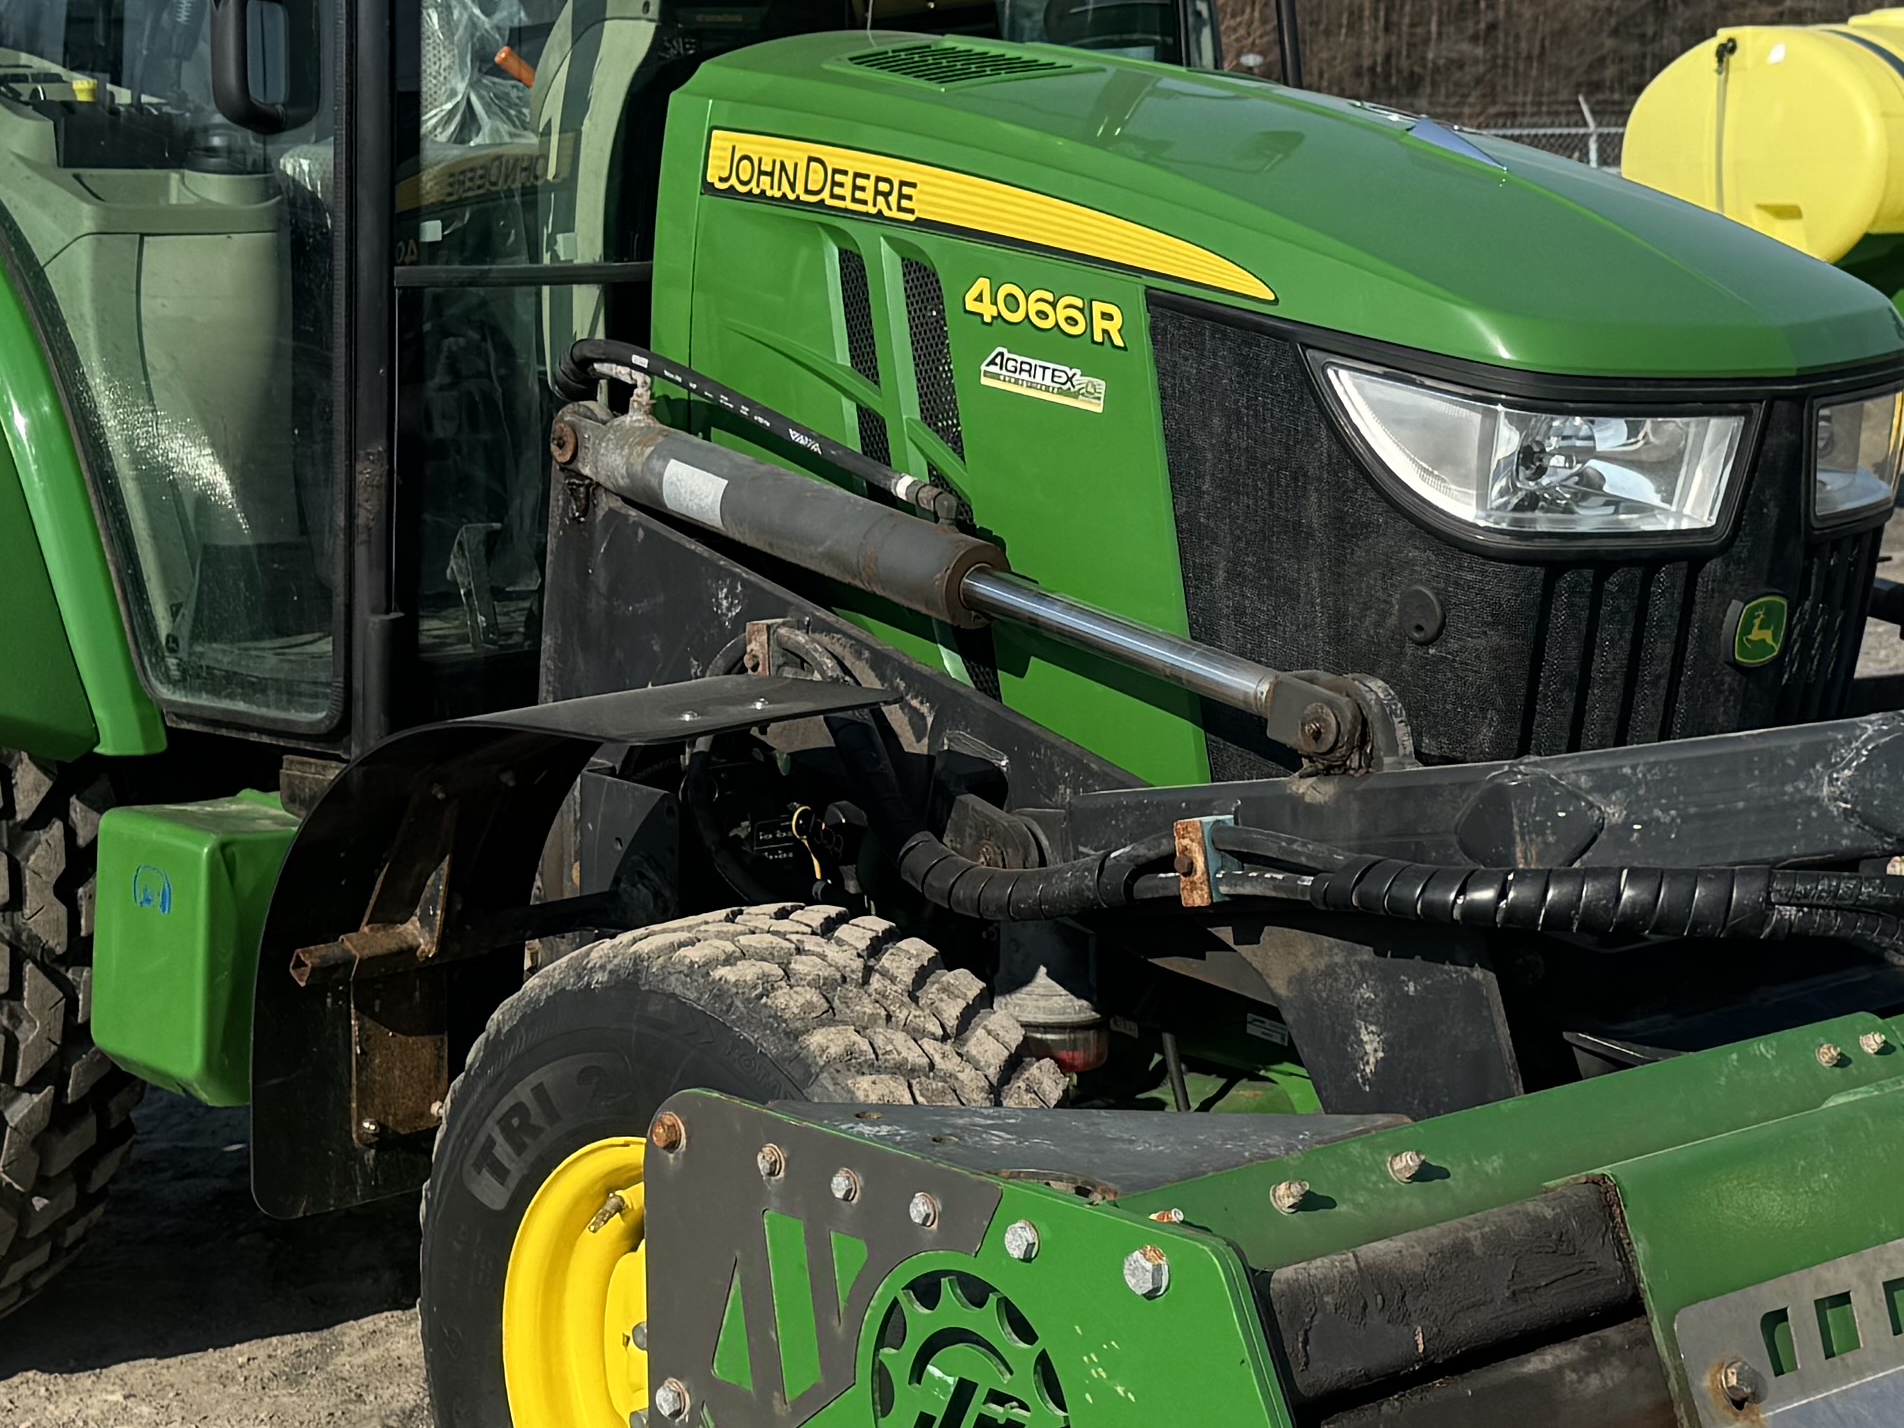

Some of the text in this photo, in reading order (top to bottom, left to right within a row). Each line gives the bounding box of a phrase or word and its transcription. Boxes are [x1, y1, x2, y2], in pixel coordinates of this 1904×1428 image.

[718, 145, 918, 215] JOHN DEERE
[985, 351, 1077, 389] AGRITEX
[471, 1085, 562, 1186] TRI
